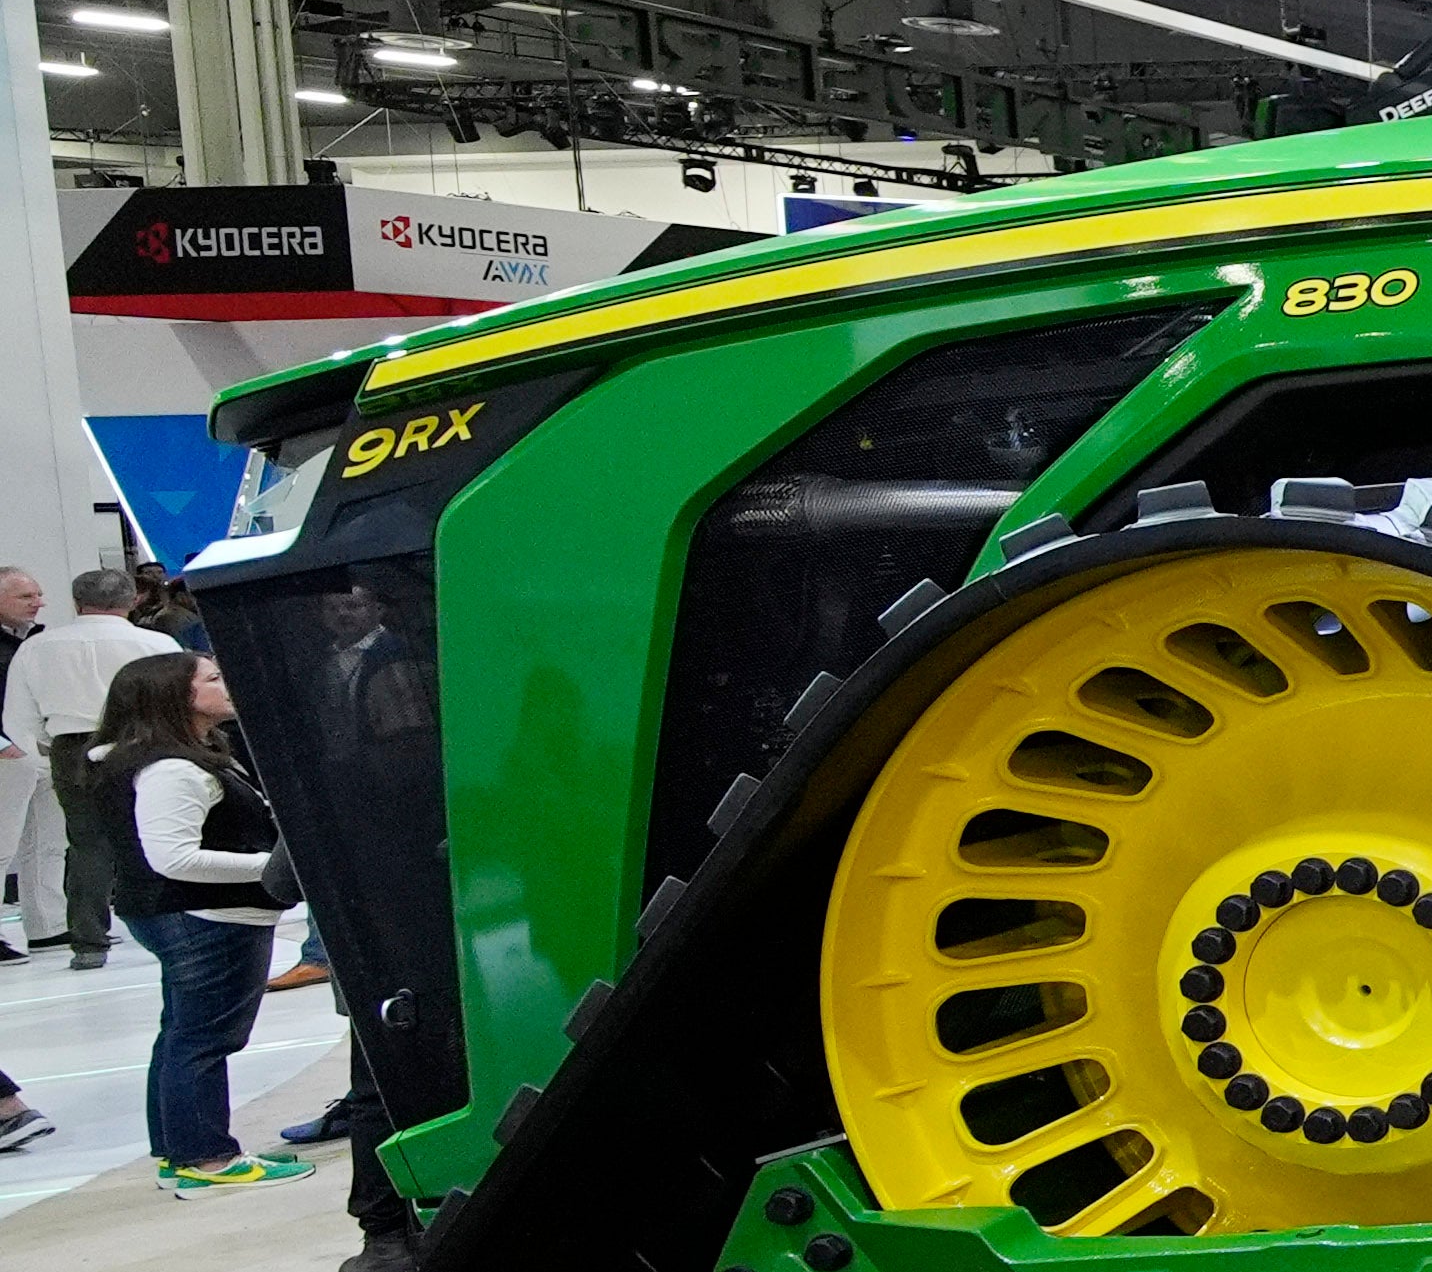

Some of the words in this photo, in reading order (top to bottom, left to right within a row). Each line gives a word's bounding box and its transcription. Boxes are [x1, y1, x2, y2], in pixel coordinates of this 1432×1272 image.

[175, 226, 324, 258] KYOCERA
[417, 223, 549, 258] KYOCERA
[1281, 268, 1420, 318] 830
[341, 401, 486, 480] 9RX
